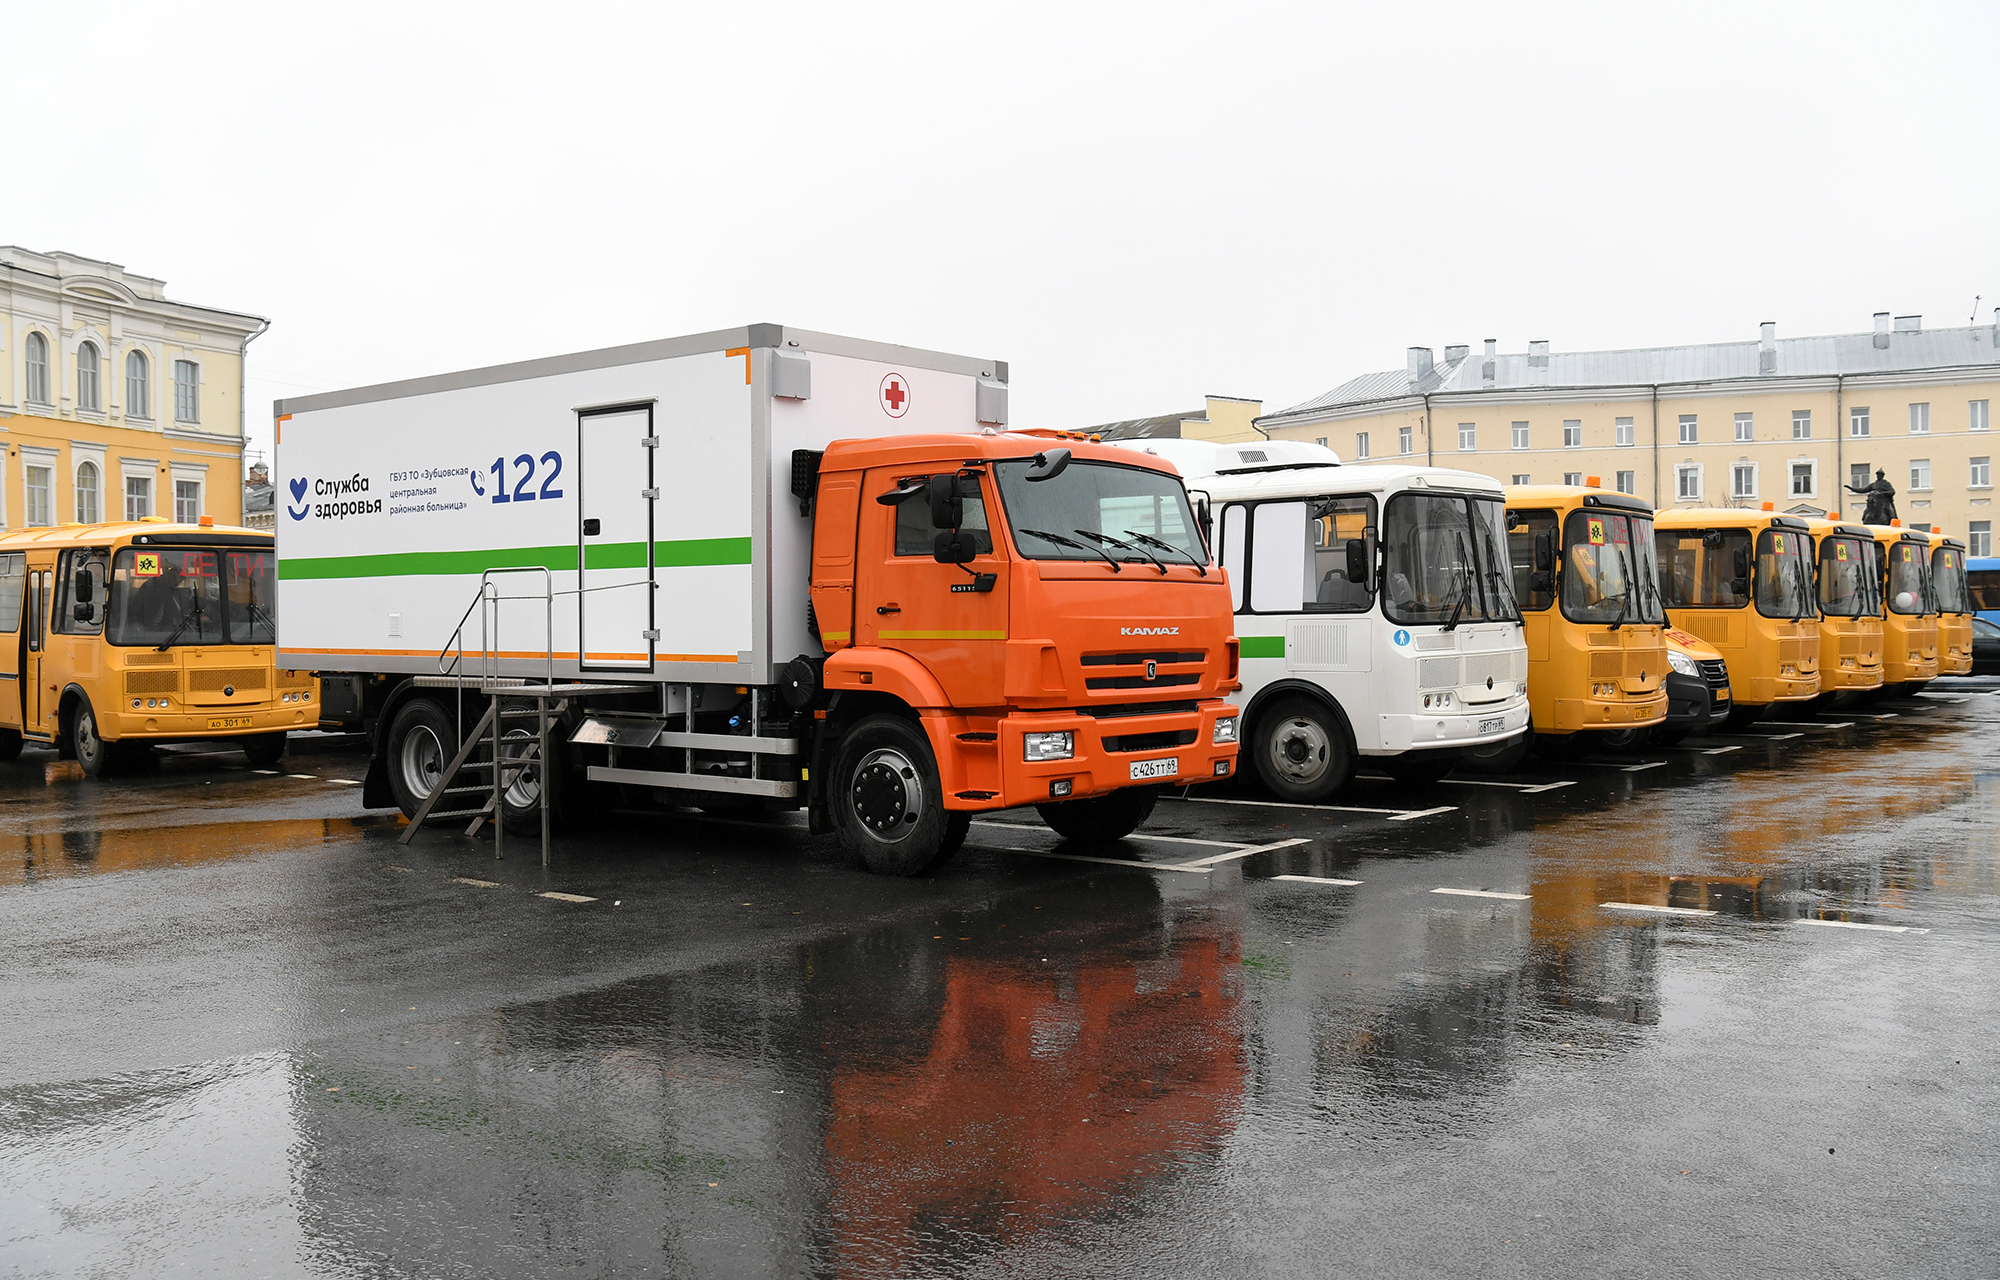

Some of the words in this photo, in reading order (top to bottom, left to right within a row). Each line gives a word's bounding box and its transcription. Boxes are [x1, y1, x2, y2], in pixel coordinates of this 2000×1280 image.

[389, 471, 408, 482] ГБУЗ
[409, 470, 419, 480] ТО
[421, 467, 469, 481] «Зубцовская
[490, 450, 563, 504] 122
[315, 472, 369, 499] Служба
[389, 487, 437, 499] центральная
[315, 499, 382, 520] здоровья
[389, 504, 425, 516] районная
[426, 501, 468, 513] больница»
[1120, 627, 1180, 636] KAMAZ
